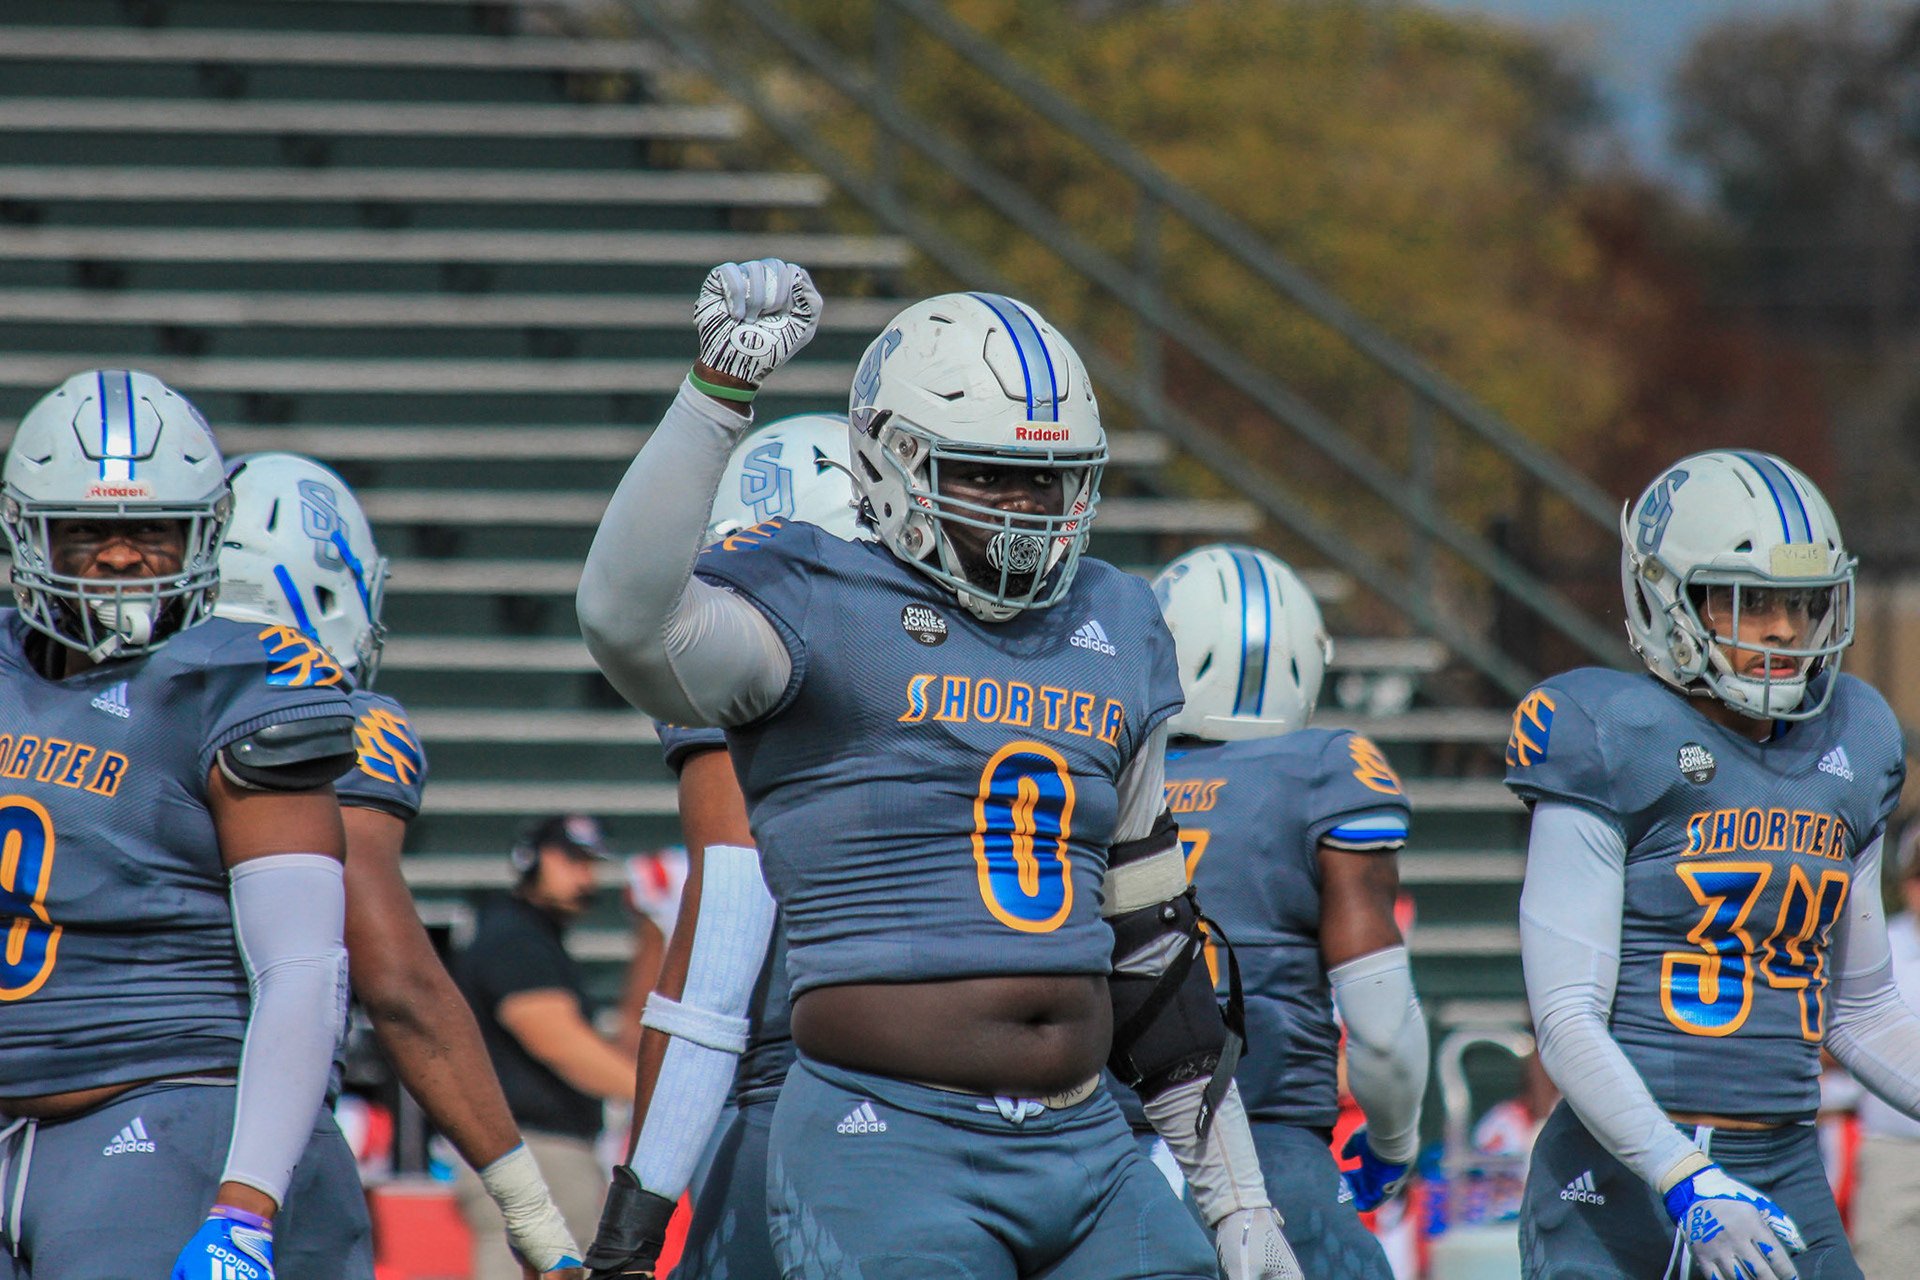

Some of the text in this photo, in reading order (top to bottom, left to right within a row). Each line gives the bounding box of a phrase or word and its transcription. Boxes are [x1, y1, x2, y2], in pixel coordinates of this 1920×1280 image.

[1015, 426, 1070, 441] Riddell
[902, 615, 946, 629] JONES
[906, 606, 937, 620] PHIL
[1069, 635, 1116, 656] adidas
[91, 698, 131, 719] adidas
[898, 674, 1124, 746] SHORTER
[1679, 753, 1713, 769] JONES
[1680, 746, 1705, 759] PHIL
[1817, 761, 1854, 782] adidas
[971, 741, 1076, 933] 0
[1680, 808, 1846, 861] SHORTER
[1660, 862, 1849, 1042] 34
[836, 1120, 887, 1134] adidas
[102, 1139, 156, 1156] adidas
[1560, 1188, 1605, 1206] adidas
[1689, 1206, 1704, 1246] adid
[206, 1243, 259, 1279] adidas
